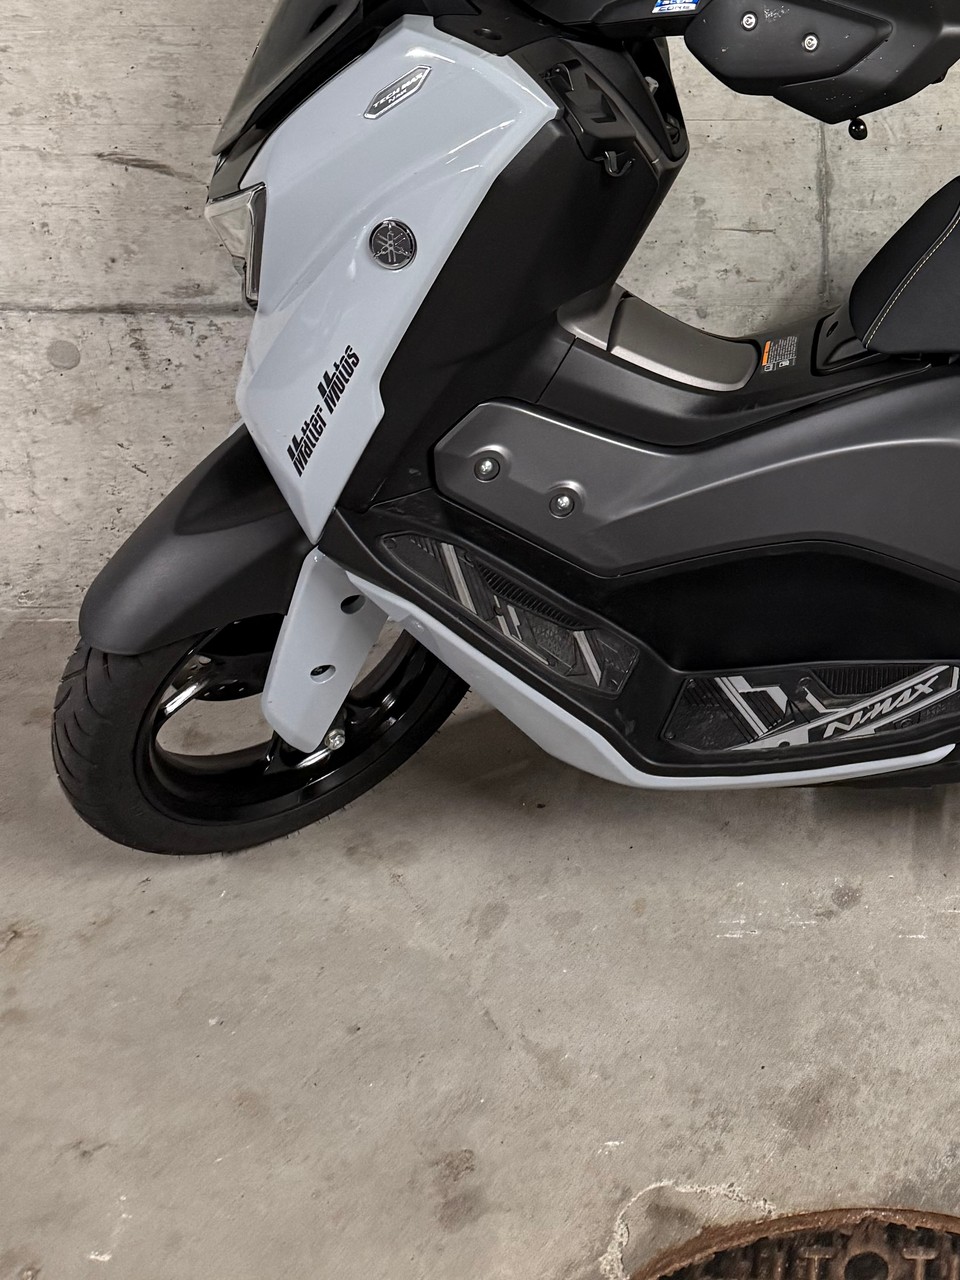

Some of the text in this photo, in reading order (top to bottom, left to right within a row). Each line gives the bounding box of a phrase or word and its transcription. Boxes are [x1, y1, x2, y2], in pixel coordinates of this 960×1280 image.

[372, 87, 401, 108] TECH
[286, 344, 360, 478] Matter Motos
[823, 675, 939, 739] NMAX
